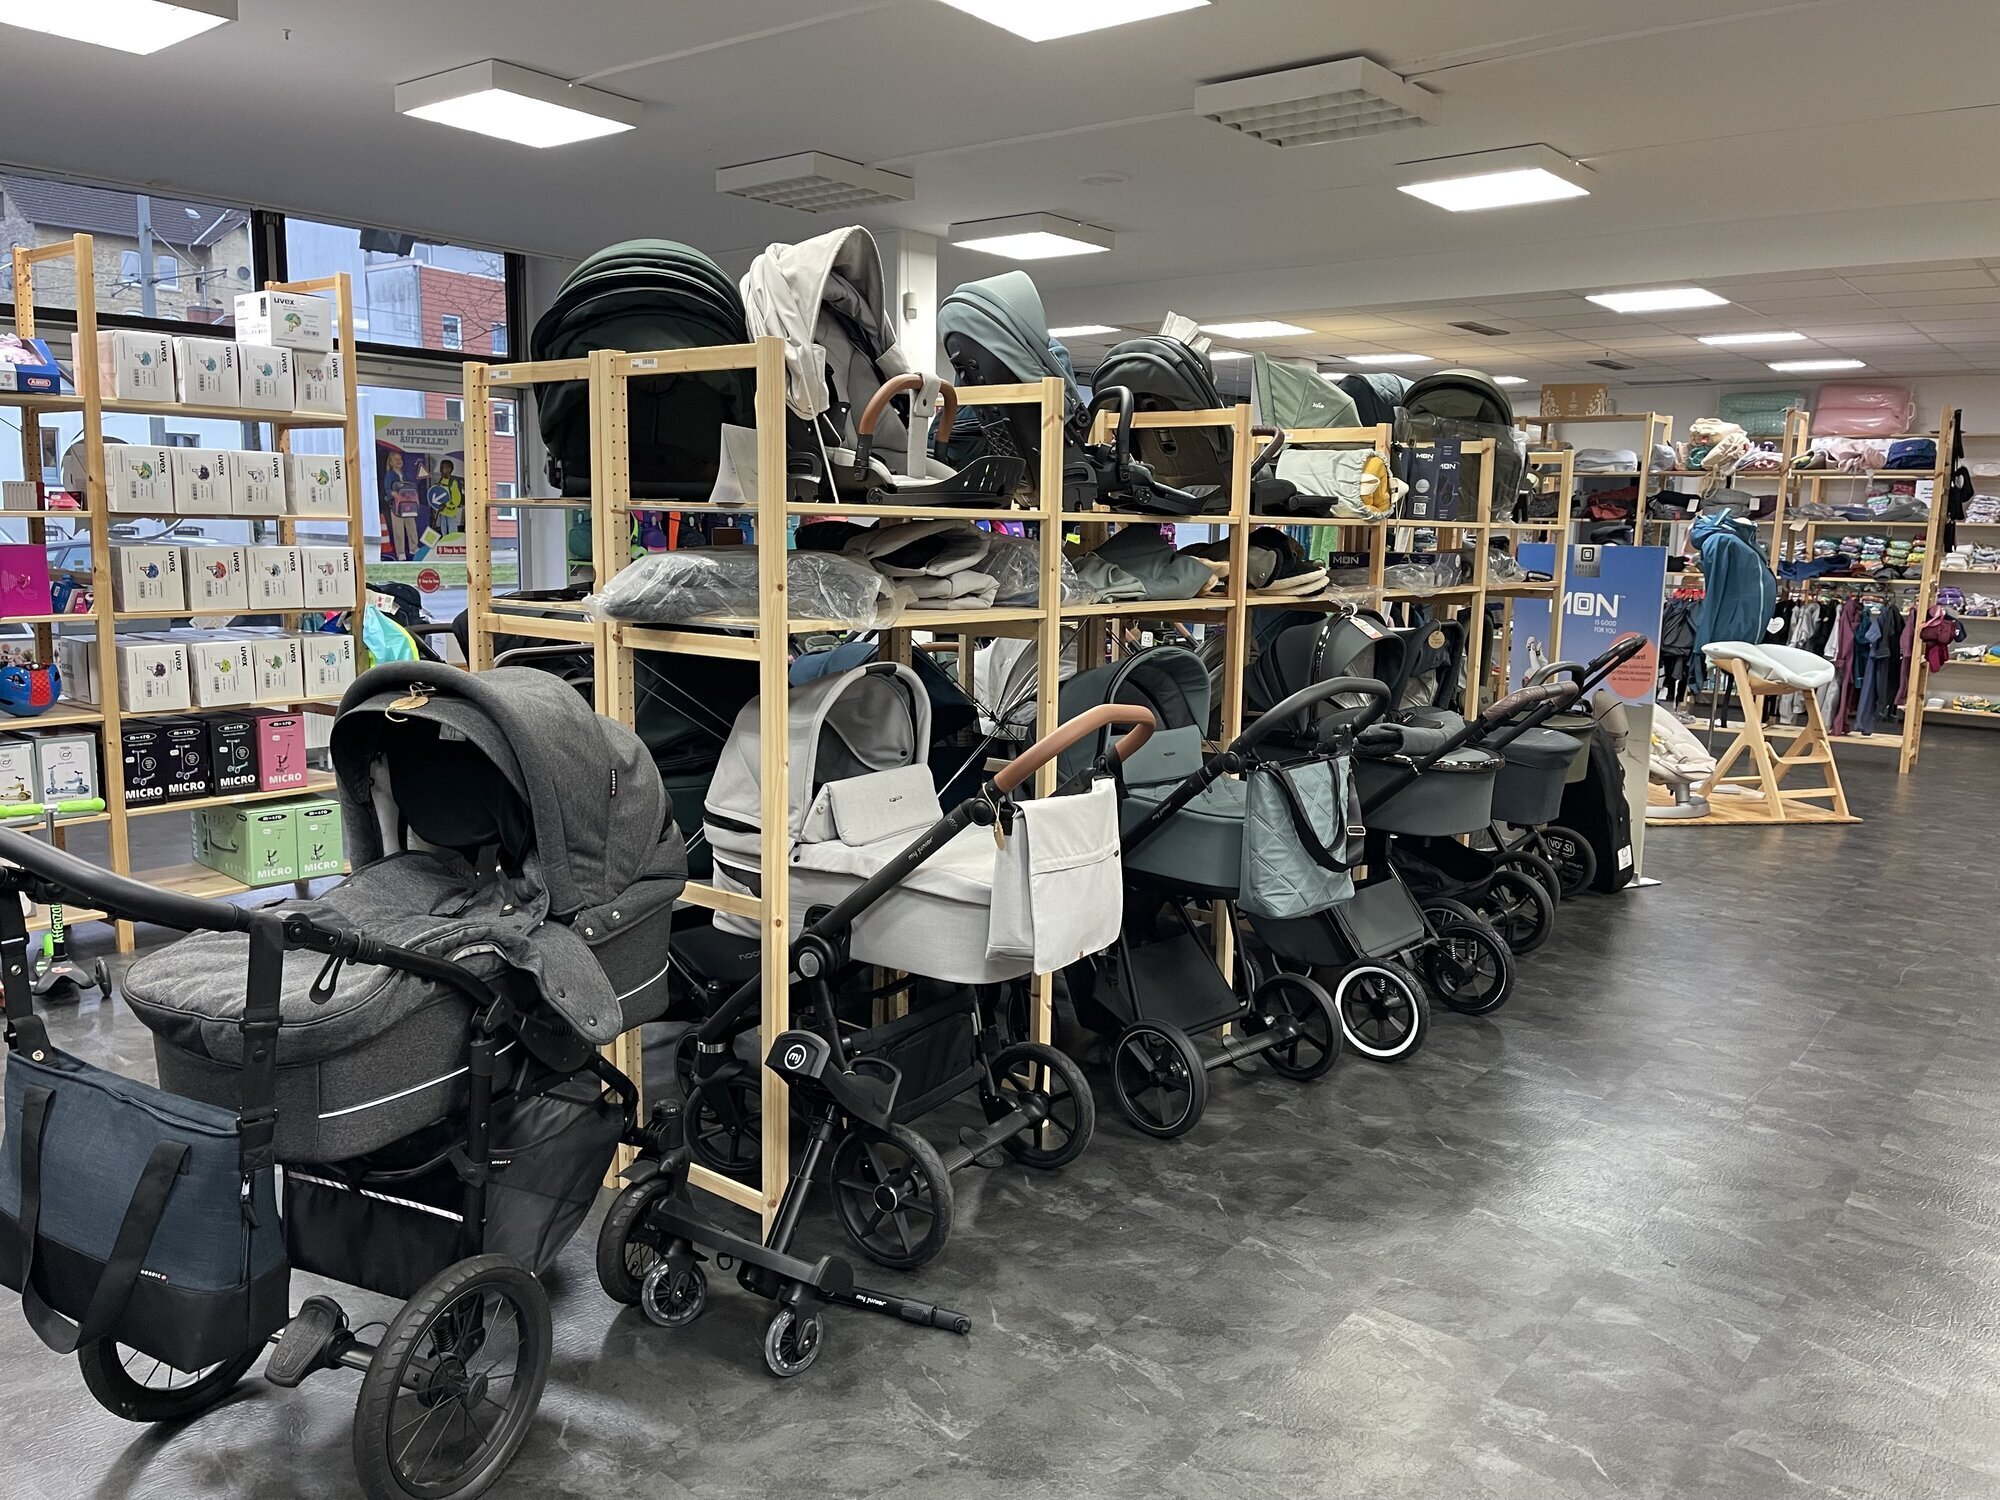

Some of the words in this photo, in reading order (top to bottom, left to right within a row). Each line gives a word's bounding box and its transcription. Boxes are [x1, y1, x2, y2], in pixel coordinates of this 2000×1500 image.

[220, 774, 256, 786] MICRO
[269, 773, 302, 784] MICRO
[126, 787, 163, 799] MICRO
[168, 781, 205, 793] MICRO
[908, 851, 918, 860] my
[917, 836, 933, 854] junior
[304, 860, 338, 872] MICRO
[257, 866, 292, 879] MICRO
[866, 1298, 887, 1306] junior
